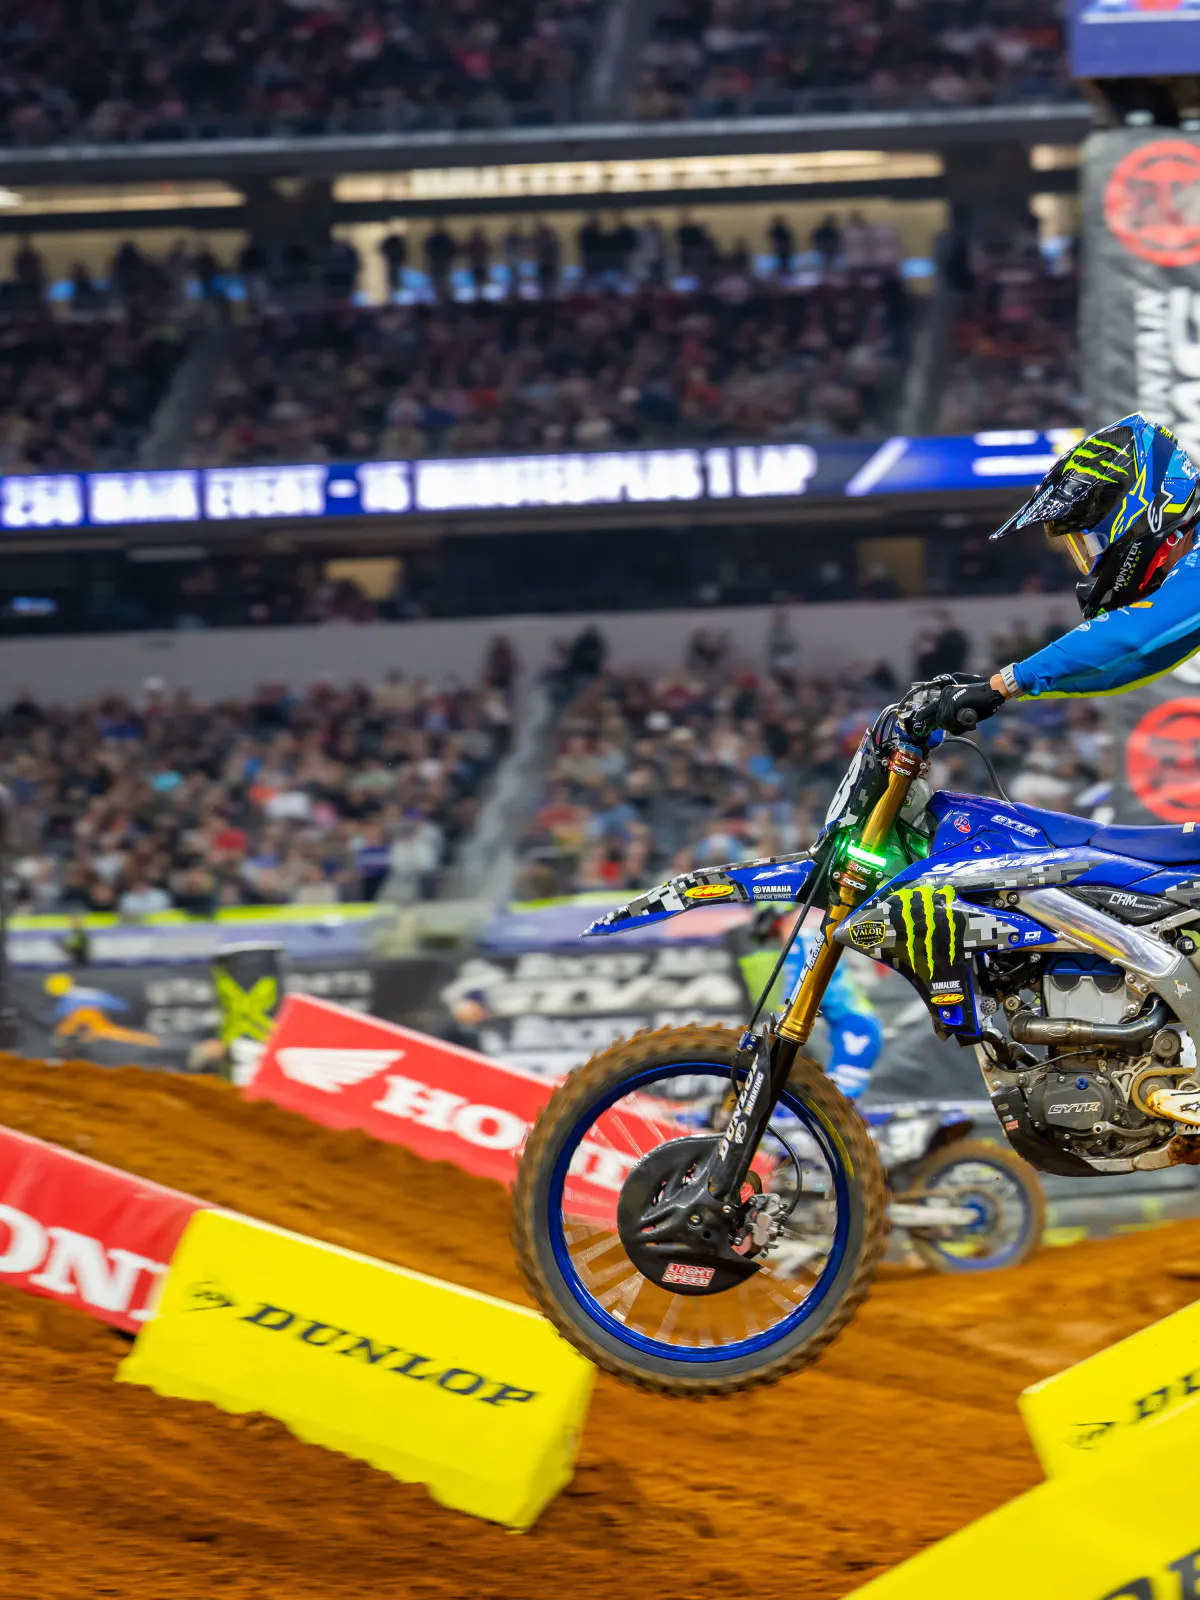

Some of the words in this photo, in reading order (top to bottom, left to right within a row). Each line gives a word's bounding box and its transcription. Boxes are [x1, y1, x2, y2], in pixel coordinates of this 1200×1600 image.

[1113, 541, 1142, 591] MONSTER
[1124, 550, 1142, 587] ENERGY
[991, 814, 1041, 836] GYTR
[762, 885, 792, 893] YAMAHA
[852, 927, 883, 937] VALOR
[931, 980, 961, 990] YAMALUBE
[719, 1053, 759, 1161] DUNLOP
[744, 1072, 764, 1117] BRAKING
[1048, 1102, 1101, 1115] GYTR
[238, 1302, 539, 1408] DUNLOP
